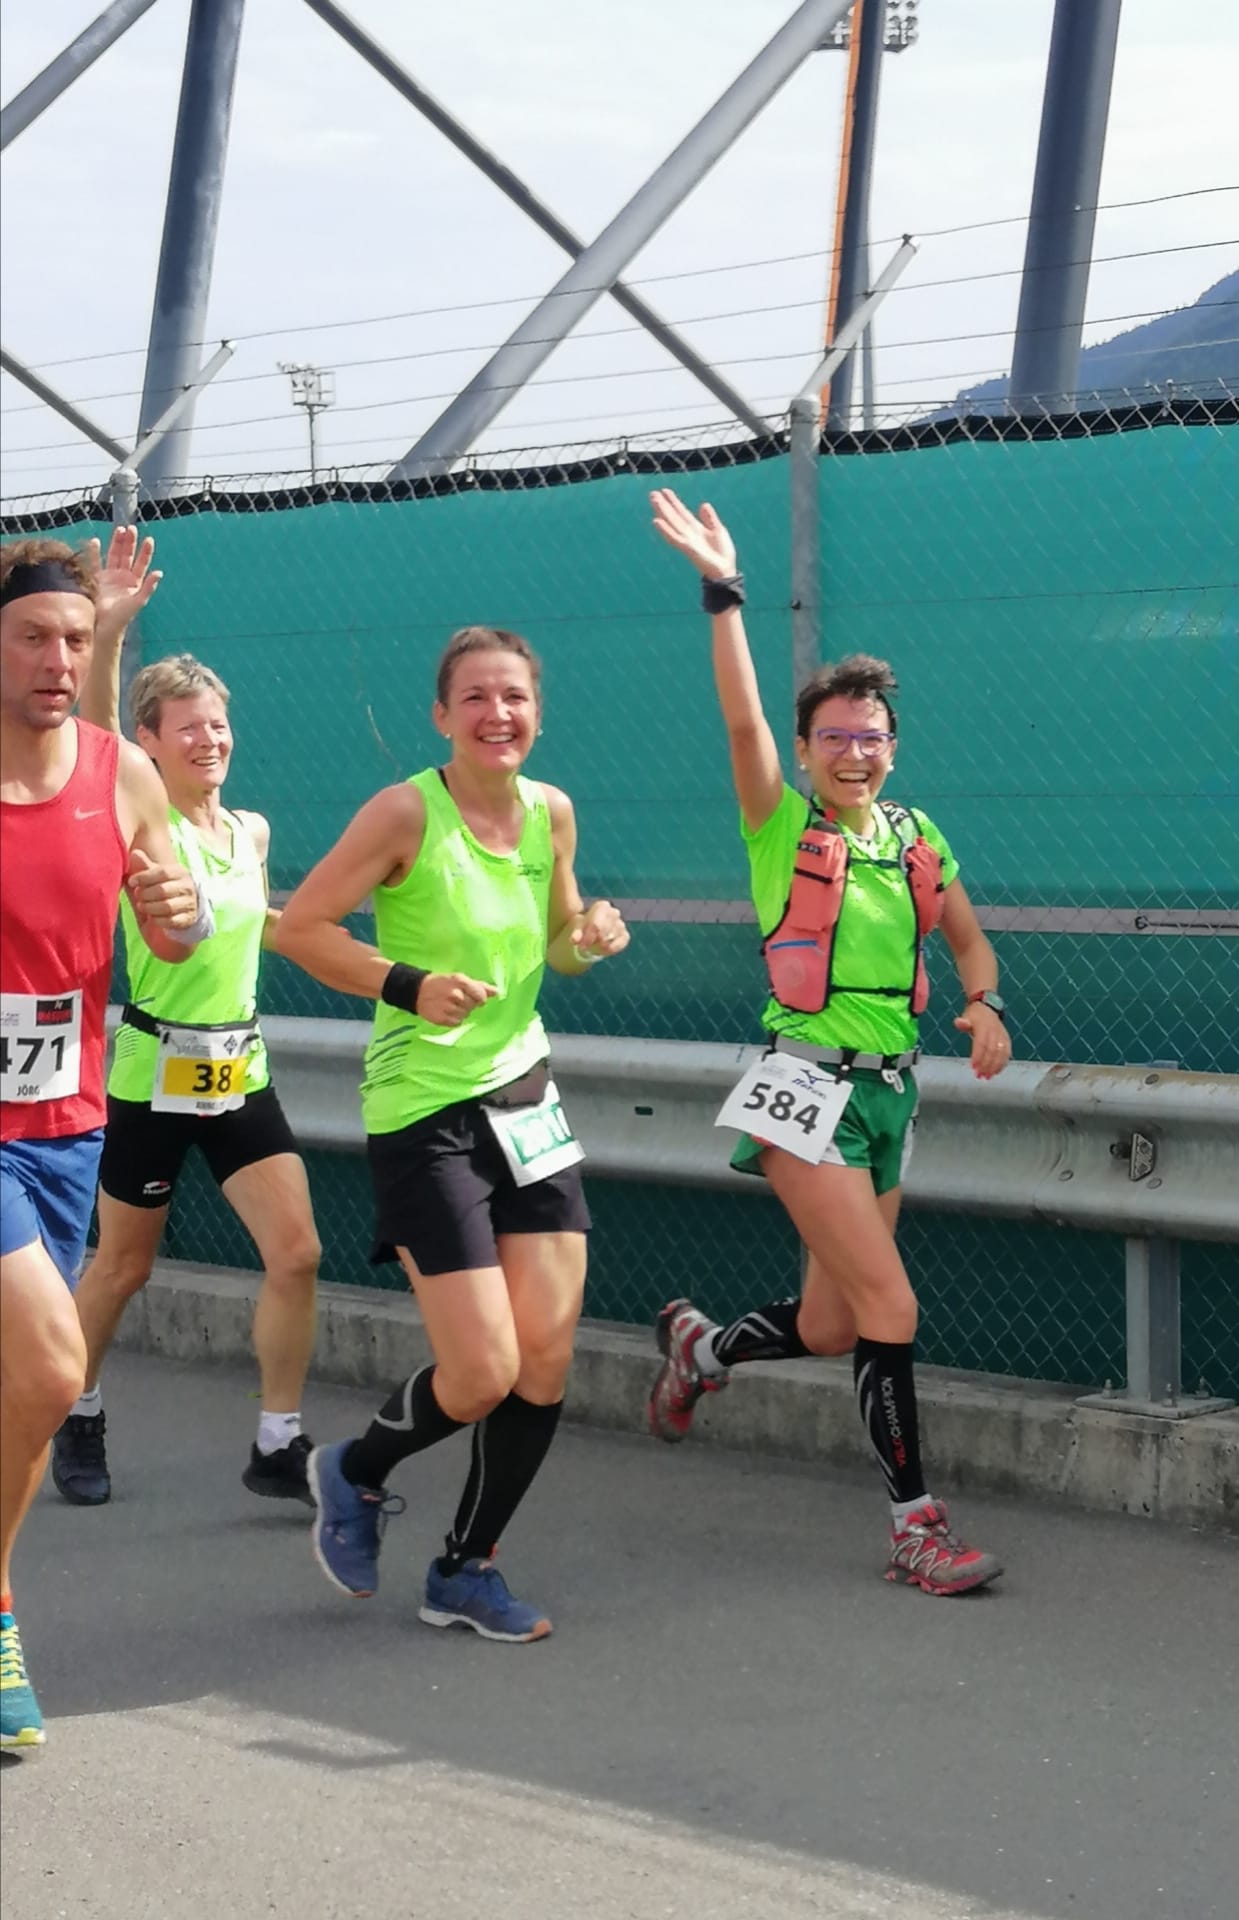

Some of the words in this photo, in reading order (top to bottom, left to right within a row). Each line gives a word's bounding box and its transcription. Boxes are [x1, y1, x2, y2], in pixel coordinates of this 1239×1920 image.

[16, 1084, 41, 1097] JÖRG
[192, 1063, 232, 1094] 38
[742, 1082, 821, 1136] 584
